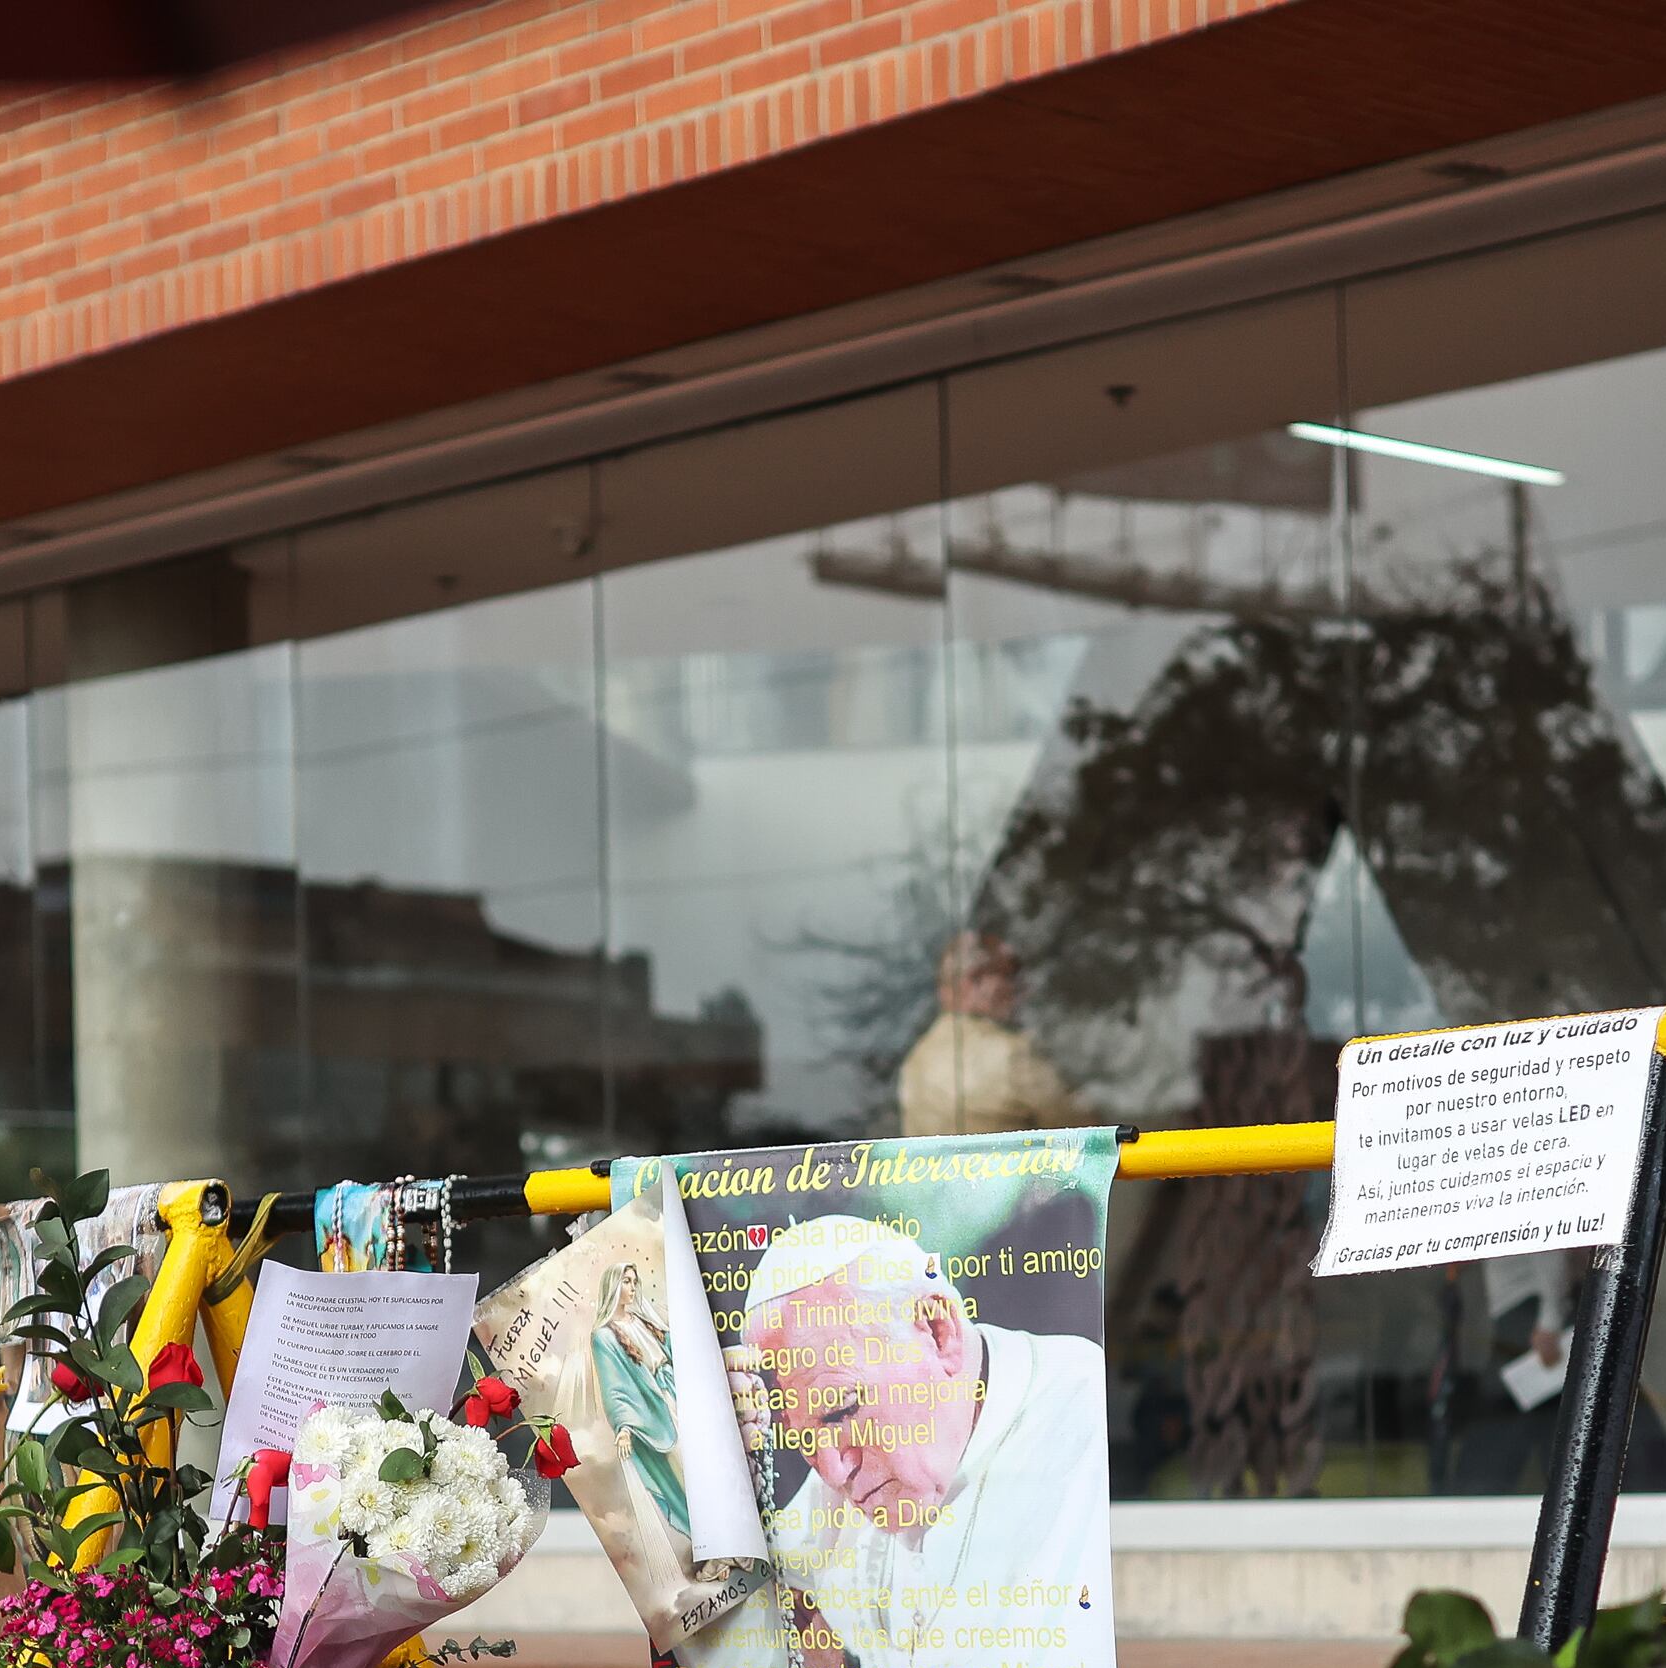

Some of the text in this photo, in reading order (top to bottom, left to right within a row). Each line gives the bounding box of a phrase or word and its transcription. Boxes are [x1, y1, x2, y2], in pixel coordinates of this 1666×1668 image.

[1356, 1017, 1637, 1065] Un detalle con luz y cuidado
[1352, 1048, 1630, 1098] Por motivos de seguridad y respeto
[1406, 1102, 1432, 1120] por
[1437, 1092, 1497, 1111] nuestro
[1359, 1104, 1614, 1148] te invitamos a usar velas LED en
[634, 1135, 1081, 1200] Oacion de Intersección
[1398, 1135, 1571, 1173] lugar de velas de cera.
[1357, 1152, 1606, 1201] Así, juntos cuidamos el espacio y
[1365, 1179, 1589, 1225] mantenemos viva la intención.
[691, 1223, 747, 1253] azón
[834, 1212, 921, 1249] partido
[1334, 1213, 1605, 1265] ¡Gracias por tu comprensión y tu luz!
[703, 1244, 1103, 1293] cción pido a Dios por ti amigo
[288, 1292, 314, 1302] AMADO
[315, 1296, 337, 1304] PADRE
[714, 1295, 978, 1332] por la Trinidad divina
[293, 1317, 319, 1328] MIGUEL
[825, 1338, 856, 1367] de
[865, 1337, 923, 1365] Dios
[808, 1375, 987, 1414] por tu mejoría
[772, 1422, 842, 1456] llegar
[851, 1417, 936, 1453] Miguel
[811, 1501, 864, 1536] pido
[874, 1507, 888, 1528] a
[898, 1499, 957, 1527] Dios
[680, 1578, 748, 1632] ESTAMOS
[776, 1584, 795, 1610] la
[803, 1584, 892, 1610] cabeza
[900, 1583, 957, 1609] ante
[967, 1581, 988, 1608] el
[998, 1579, 1072, 1607] señor
[854, 1627, 1067, 1655] los que creemos
